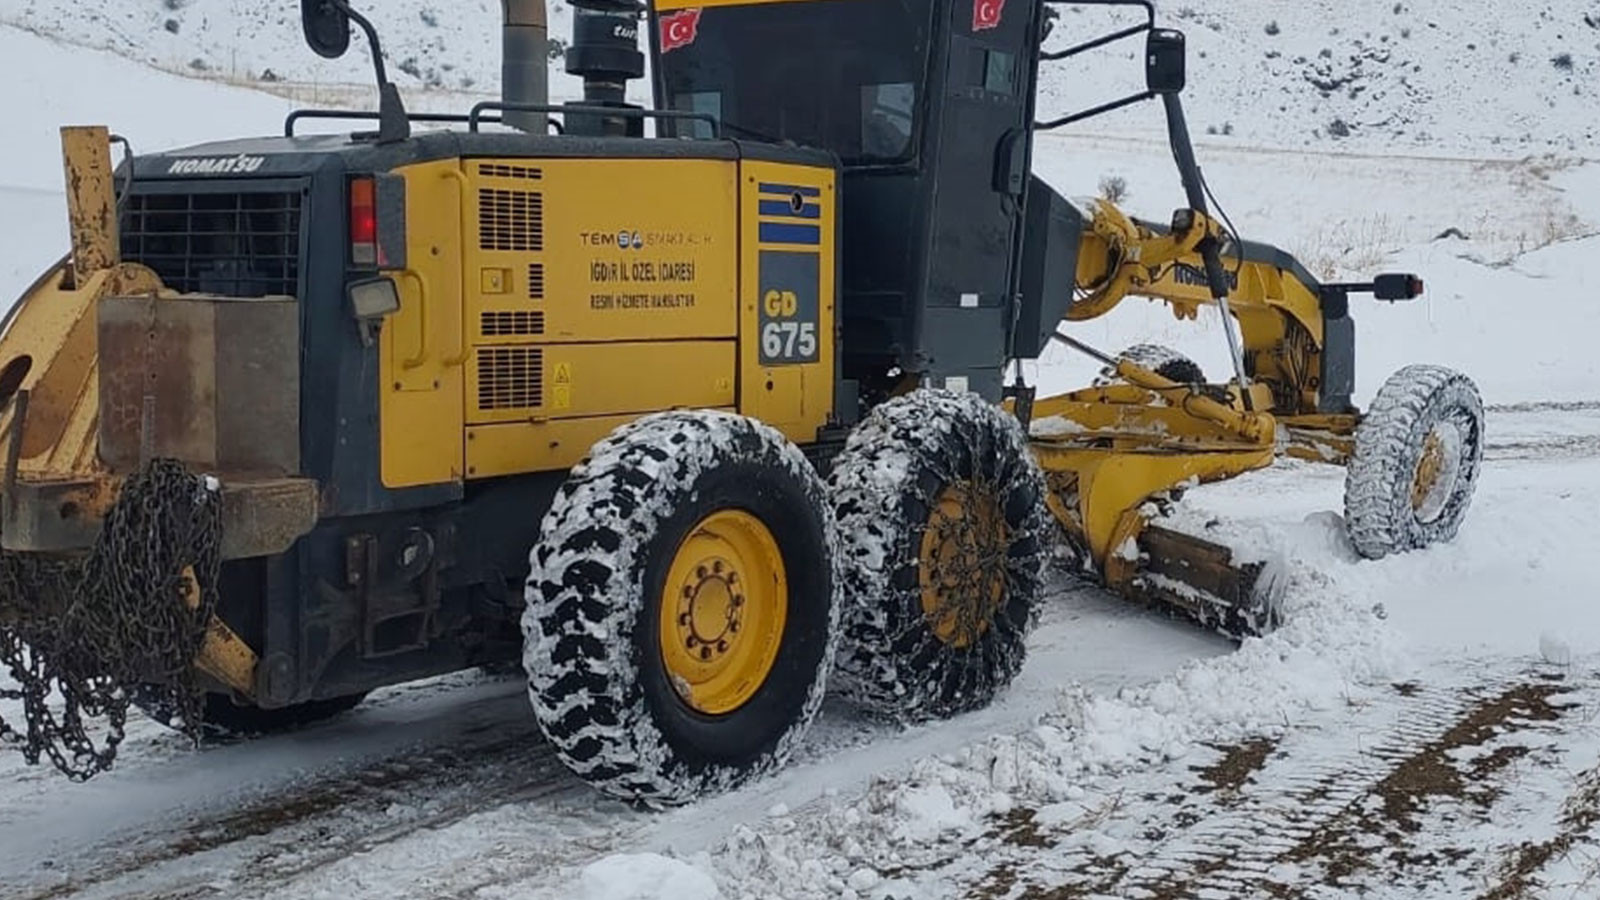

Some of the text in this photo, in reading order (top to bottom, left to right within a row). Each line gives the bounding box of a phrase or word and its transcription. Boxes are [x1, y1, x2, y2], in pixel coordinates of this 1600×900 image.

[167, 153, 265, 174] KOMATSU
[580, 230, 643, 249] TEMSA
[764, 290, 797, 317] GD
[762, 322, 816, 358] 675
